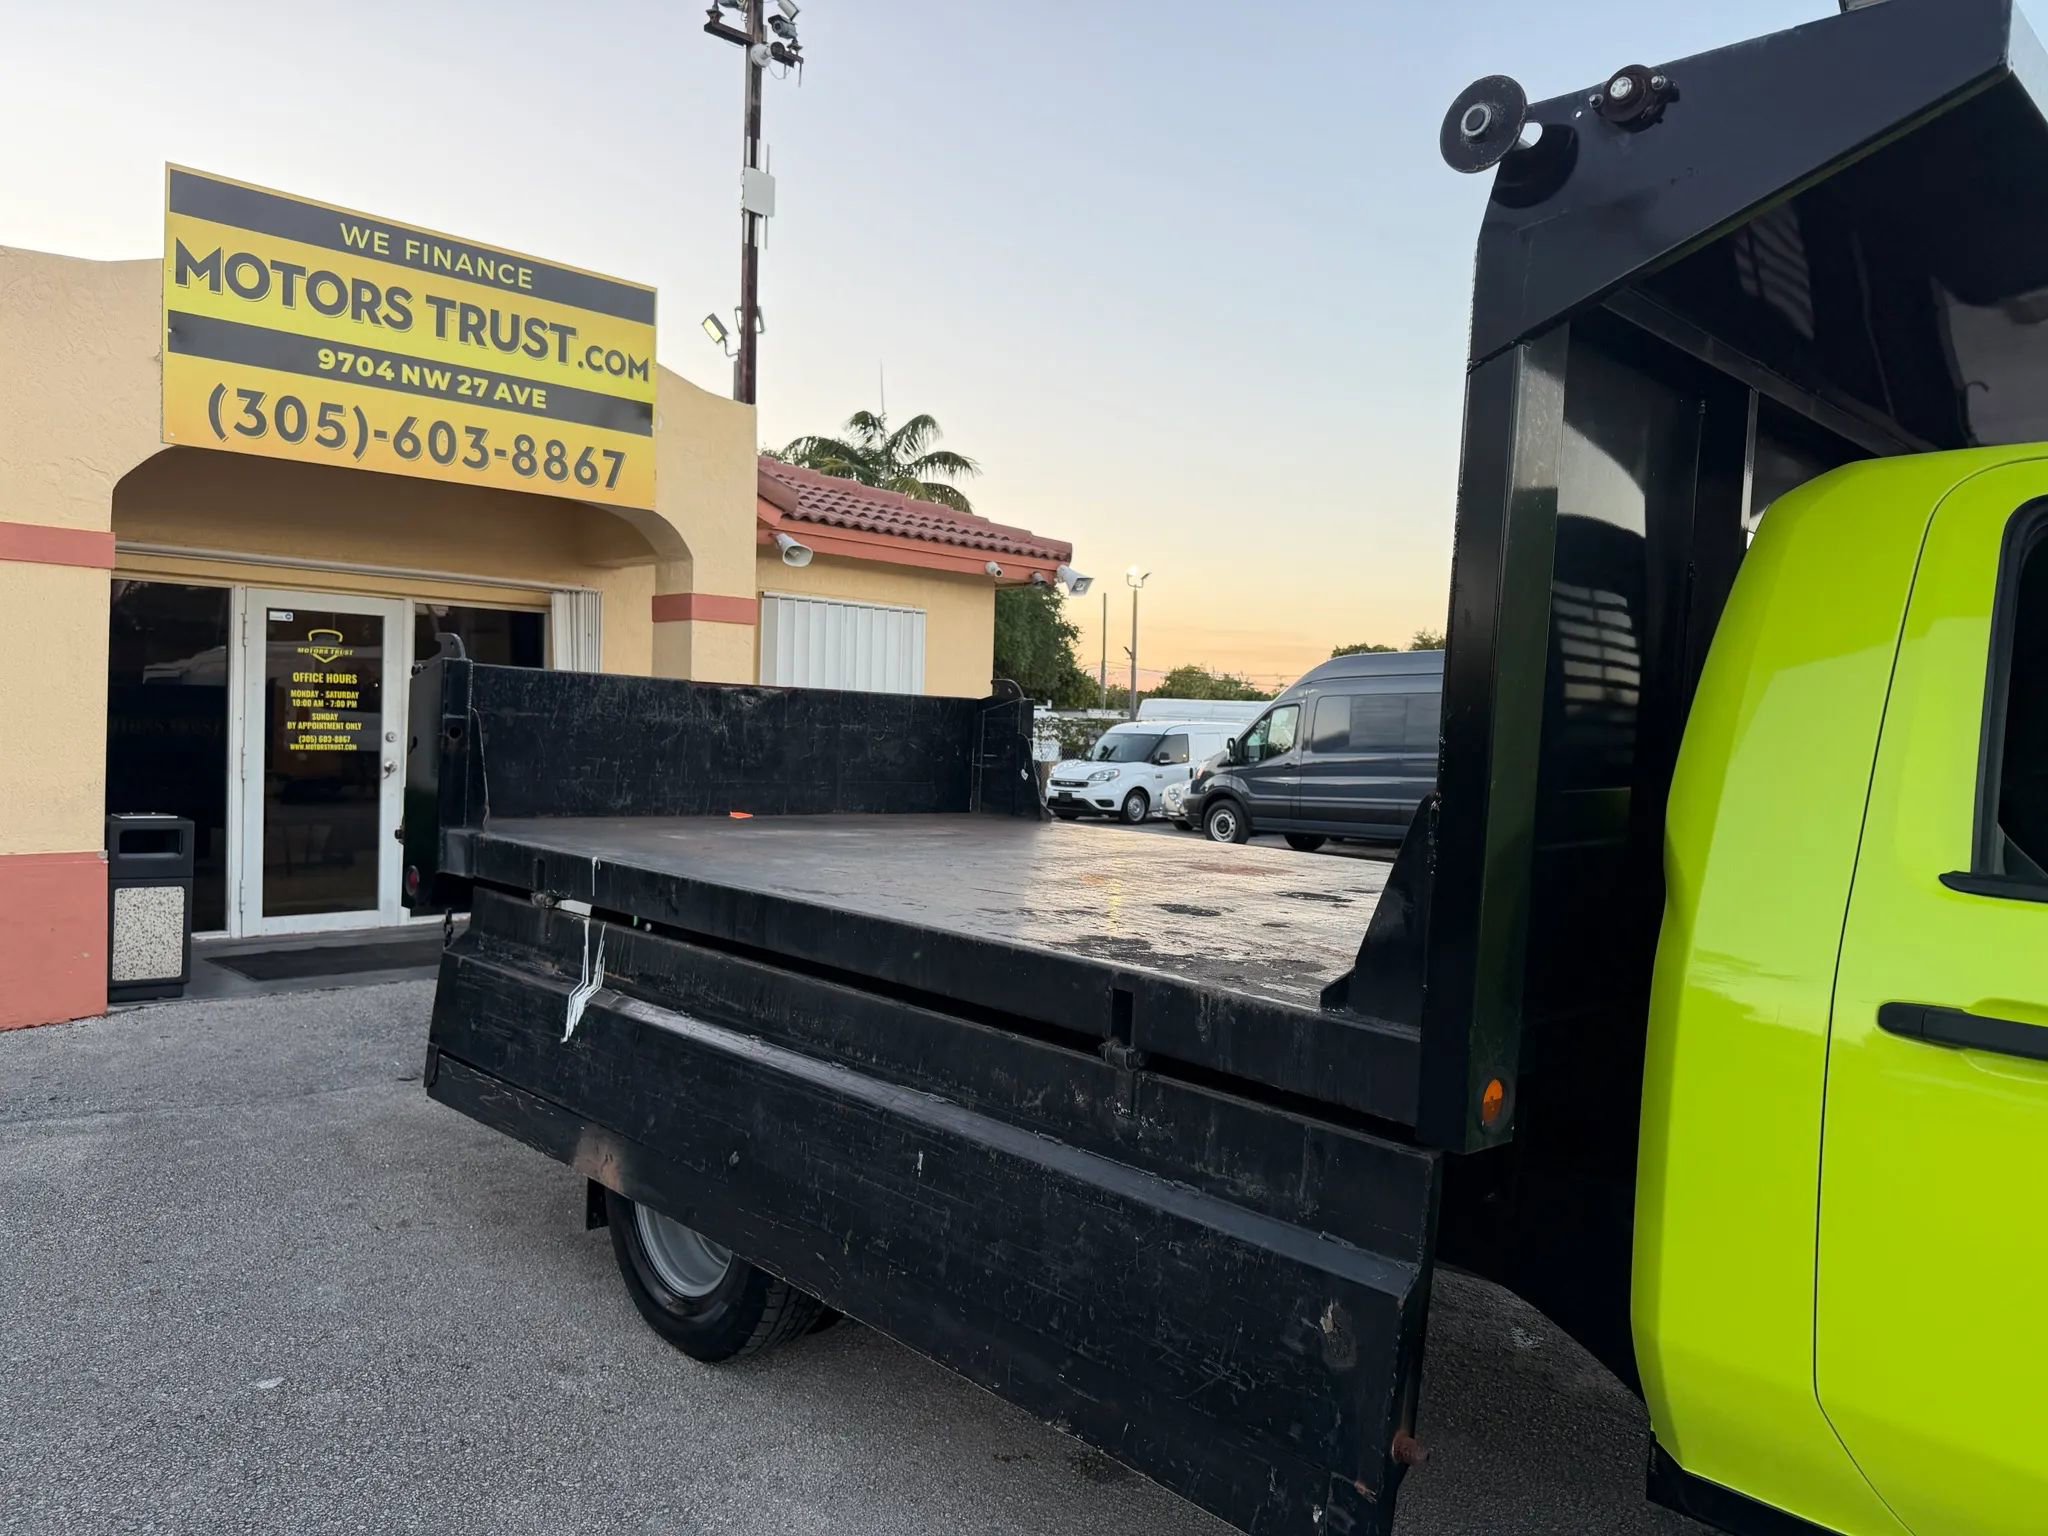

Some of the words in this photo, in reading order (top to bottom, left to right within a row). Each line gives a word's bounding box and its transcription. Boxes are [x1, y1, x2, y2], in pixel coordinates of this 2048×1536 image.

[340, 222, 390, 255] WE
[406, 239, 533, 289] FINANCE
[175, 236, 414, 334] MOTORS
[317, 348, 395, 382] 9704
[401, 363, 452, 391] NW
[456, 374, 489, 399] 27
[493, 382, 547, 409] AVE
[208, 382, 627, 491] (305)-603-8867
[292, 671, 324, 683] OFFICE
[326, 673, 358, 684] HOURS
[290, 689, 319, 698] MONDAY
[325, 690, 359, 699] SATURDAY
[292, 699, 312, 707] 10:00
[313, 699, 324, 707] AM
[330, 700, 345, 708] 7:00
[346, 700, 358, 708] PM
[312, 712, 338, 721] SUNDAY
[287, 721, 297, 730] BY
[298, 721, 344, 730] APPOINTMENT
[345, 722, 362, 731] ONLY
[298, 735, 317, 744] (305)
